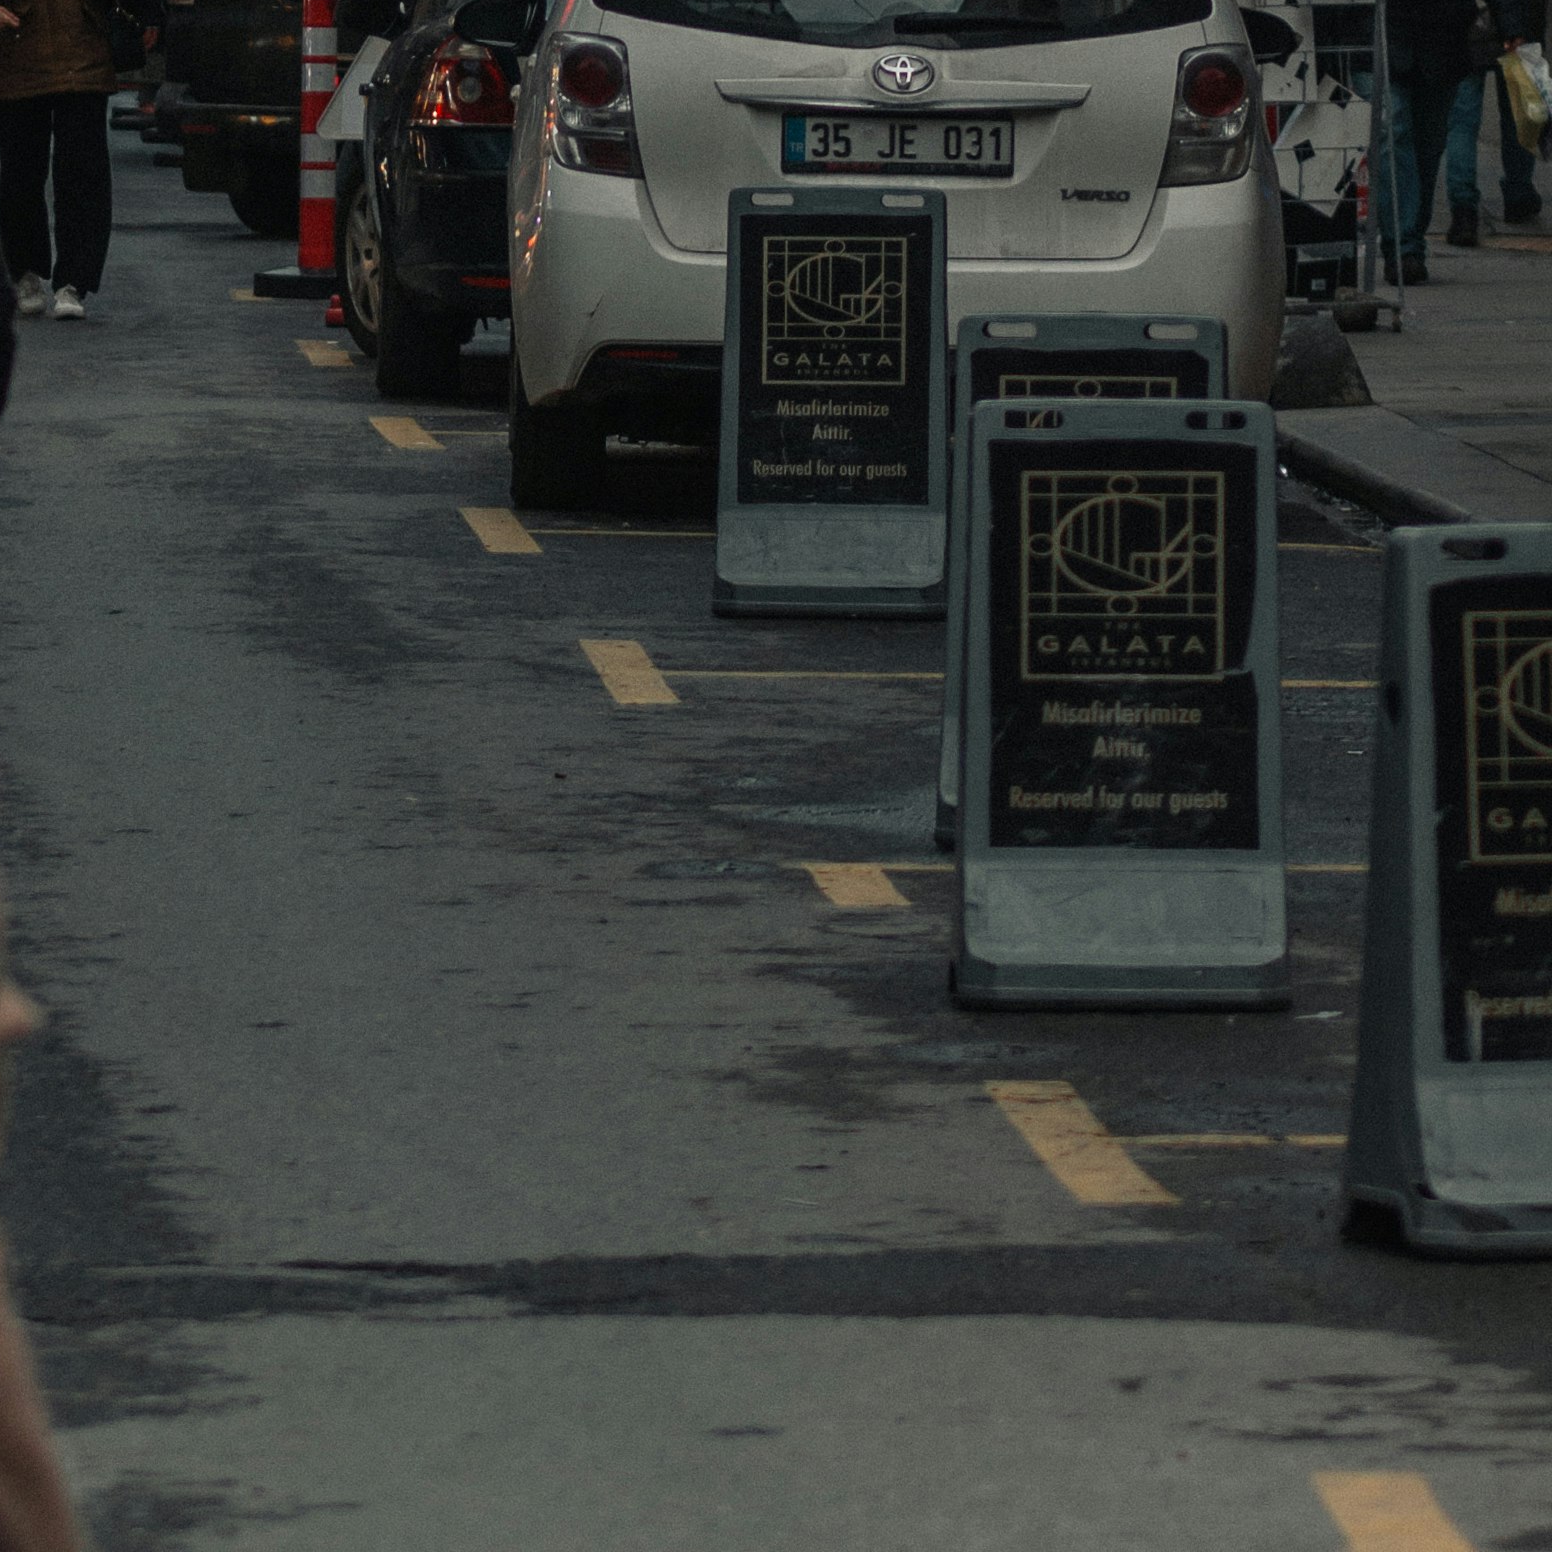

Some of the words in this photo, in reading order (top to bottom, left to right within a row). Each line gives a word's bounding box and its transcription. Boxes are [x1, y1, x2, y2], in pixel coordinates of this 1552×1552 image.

[790, 142, 804, 153] TR
[811, 123, 851, 158] 35
[877, 123, 917, 159] JE
[943, 125, 1002, 161] 031
[1060, 188, 1131, 203] VERSO
[772, 352, 893, 366] GALATA
[776, 398, 891, 417] Misafirlerimize
[752, 459, 813, 477] Reserved
[816, 459, 836, 475] for
[839, 464, 863, 476] our
[865, 462, 908, 481] guests
[1036, 634, 1206, 654] GALATA
[1041, 699, 1203, 725] Misafirlerimize
[1008, 784, 1094, 810] Reserved
[1099, 784, 1125, 809] for
[1131, 791, 1165, 809] our
[1169, 788, 1229, 816] guests
